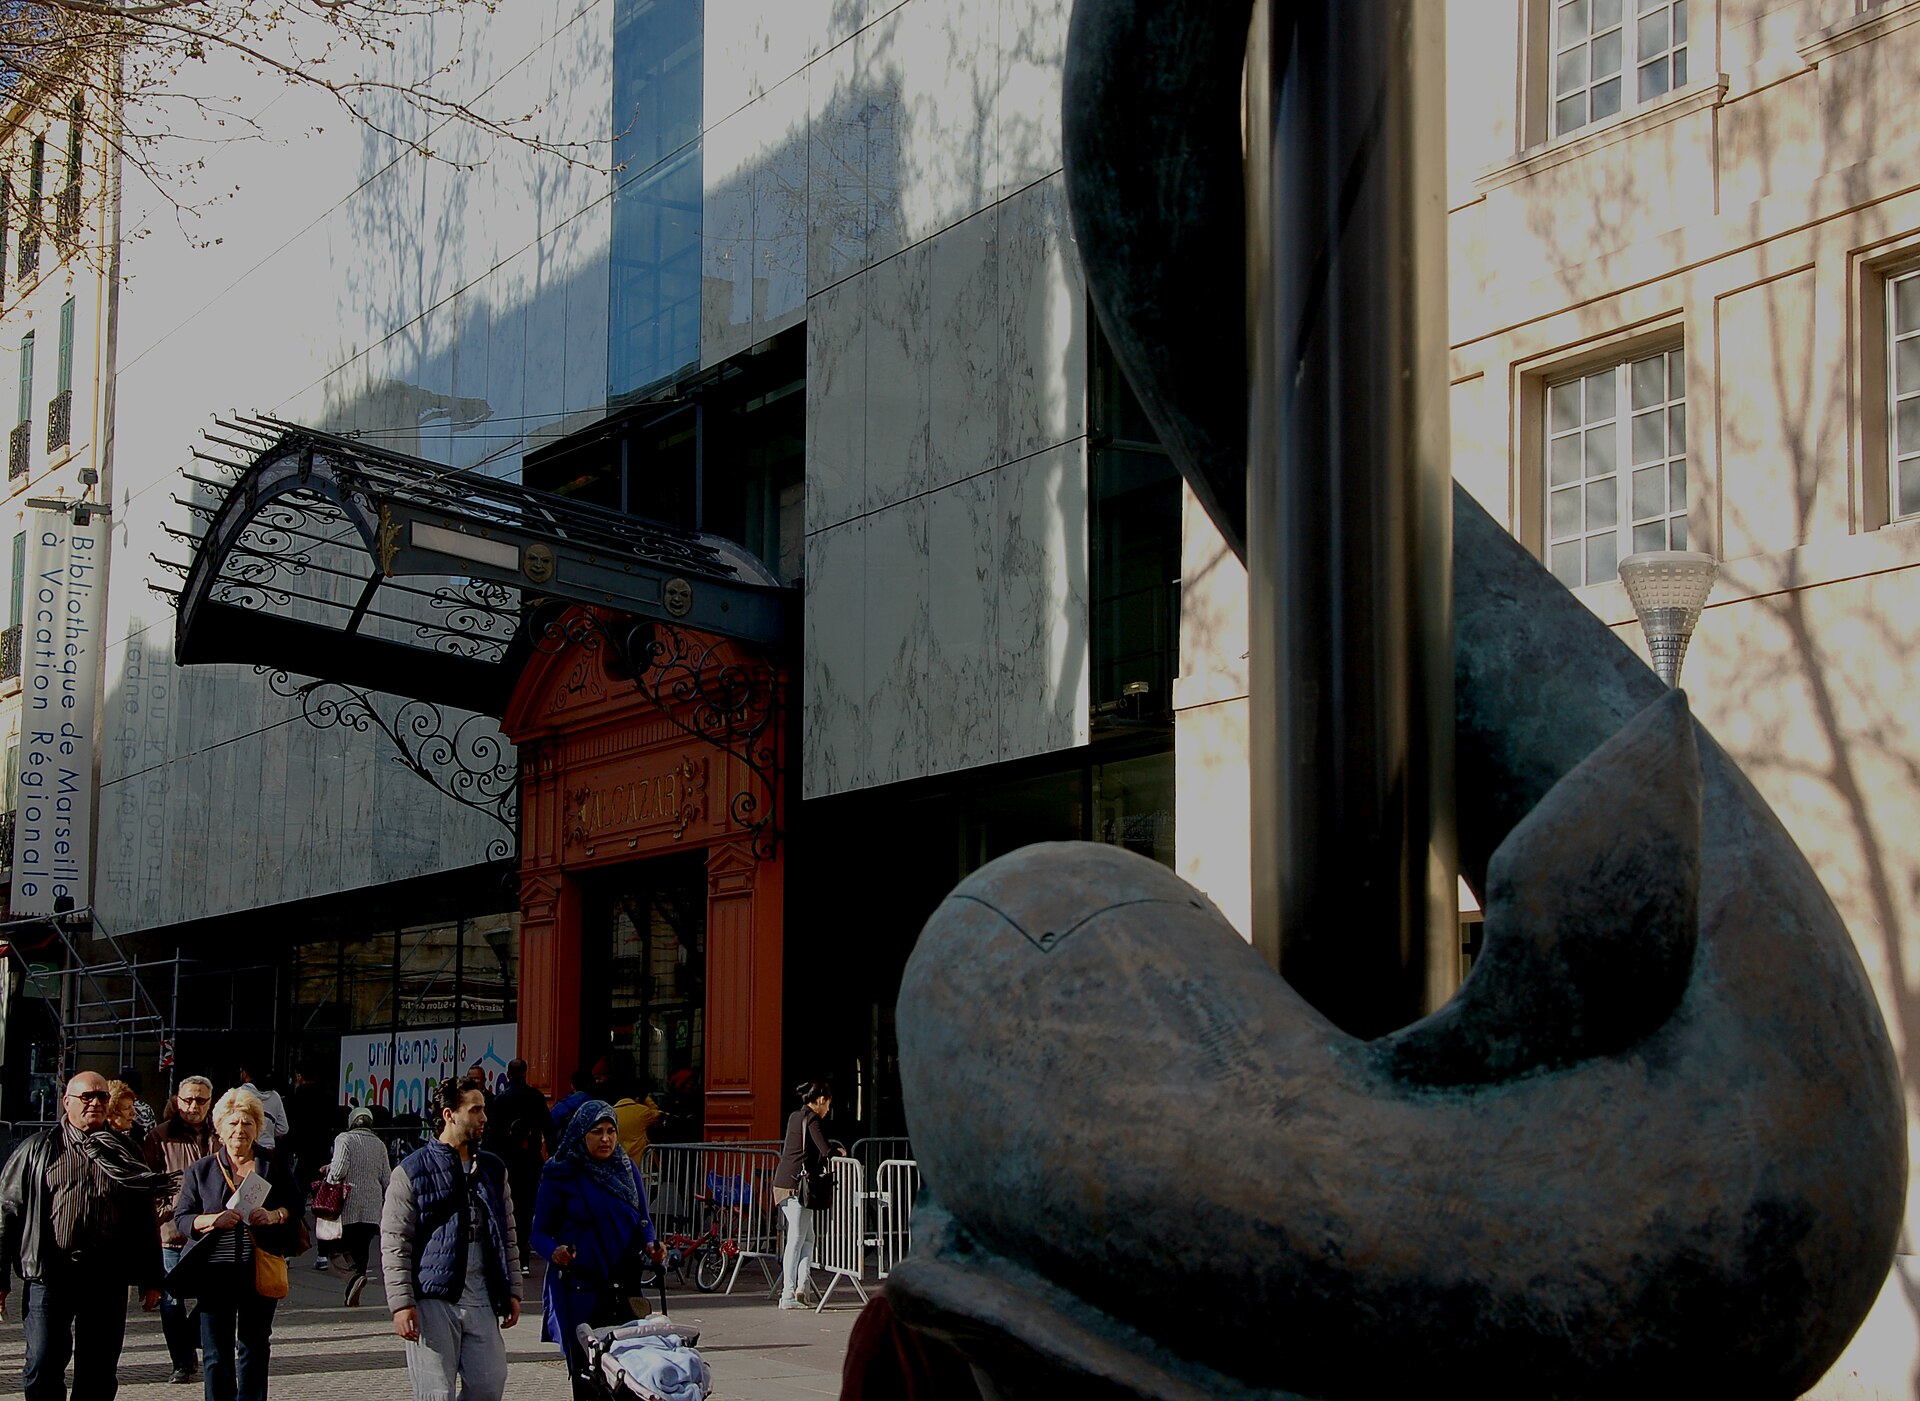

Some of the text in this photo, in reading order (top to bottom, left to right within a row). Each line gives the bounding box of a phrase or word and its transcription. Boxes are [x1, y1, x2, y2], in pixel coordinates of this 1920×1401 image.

[21, 531, 65, 897] à Vocation Régionale
[52, 536, 94, 898] Bibliothèque de Marseille
[589, 774, 677, 832] ALCAZAR
[368, 1037, 438, 1072] printemps
